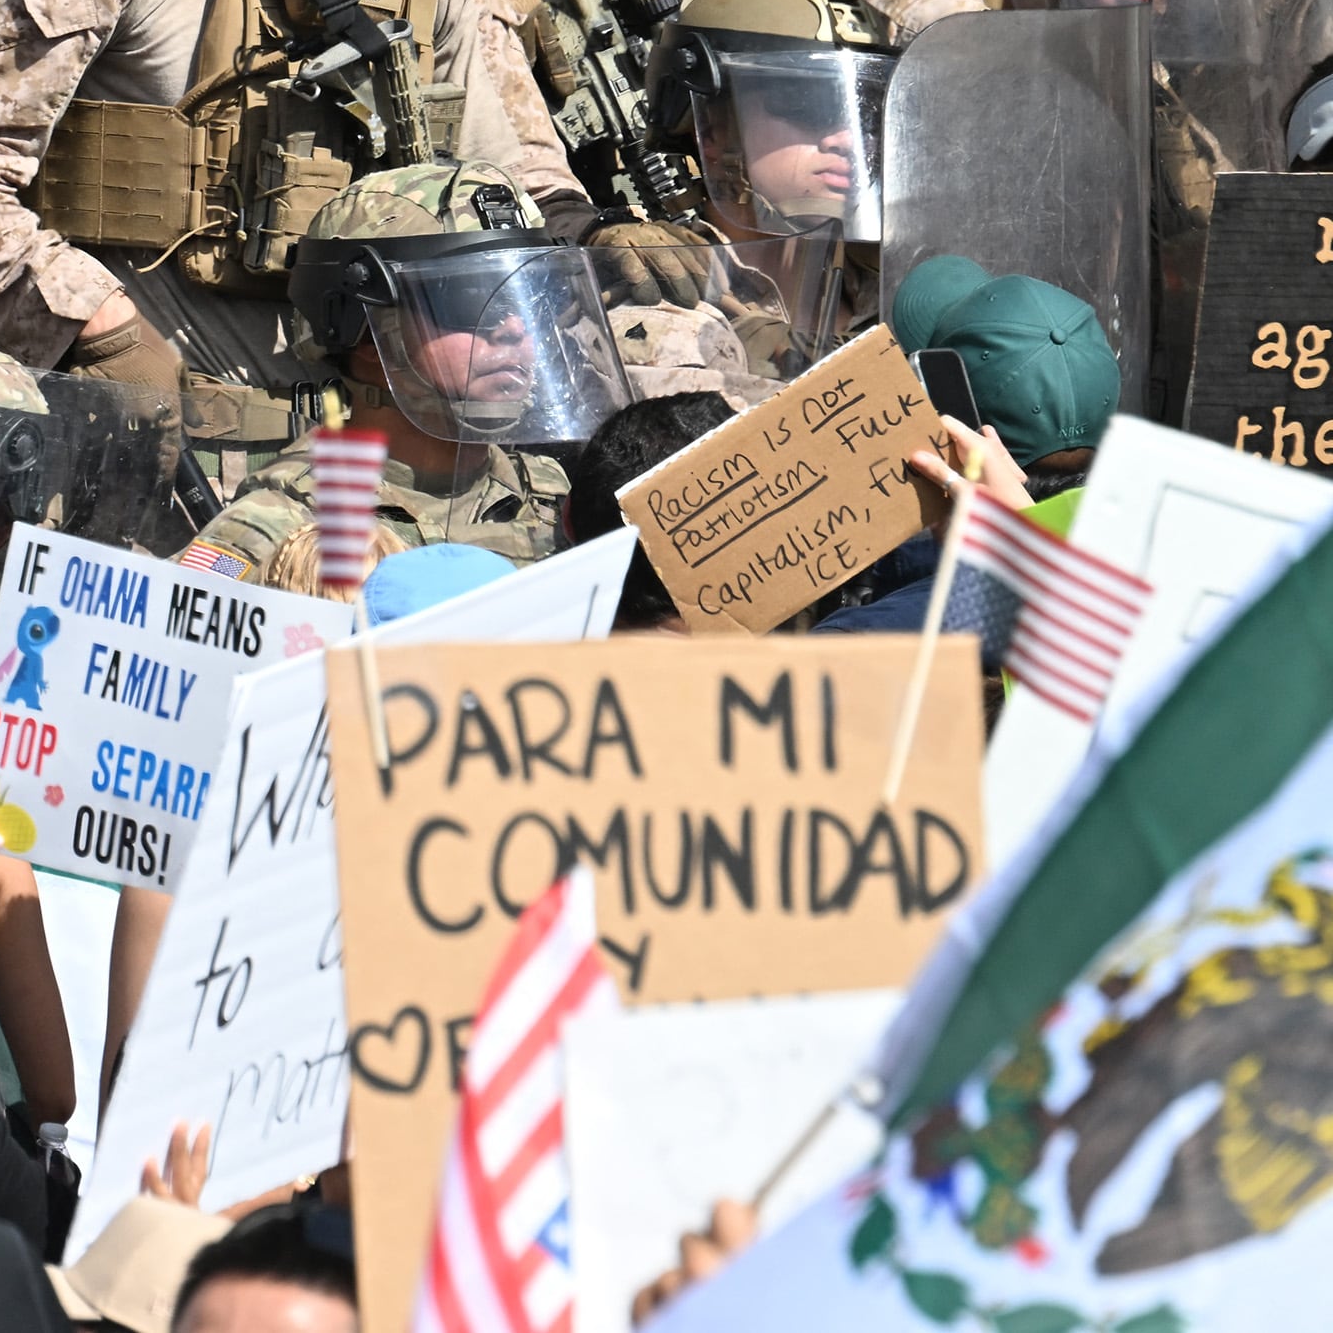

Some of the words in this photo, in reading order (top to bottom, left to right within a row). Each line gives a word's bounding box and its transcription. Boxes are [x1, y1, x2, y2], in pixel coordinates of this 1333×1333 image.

[1059, 423, 1089, 438] NIKE
[647, 452, 755, 531] Racism
[18, 541, 50, 595] IF
[59, 555, 150, 629] OHANA
[165, 583, 267, 658] MEANS
[83, 642, 198, 723] FAMILY
[373, 675, 645, 800] PARA
[718, 668, 840, 773] MI
[72, 805, 172, 886] OURS!
[405, 805, 972, 936] COMUNIDAD
[187, 916, 254, 1052] to
